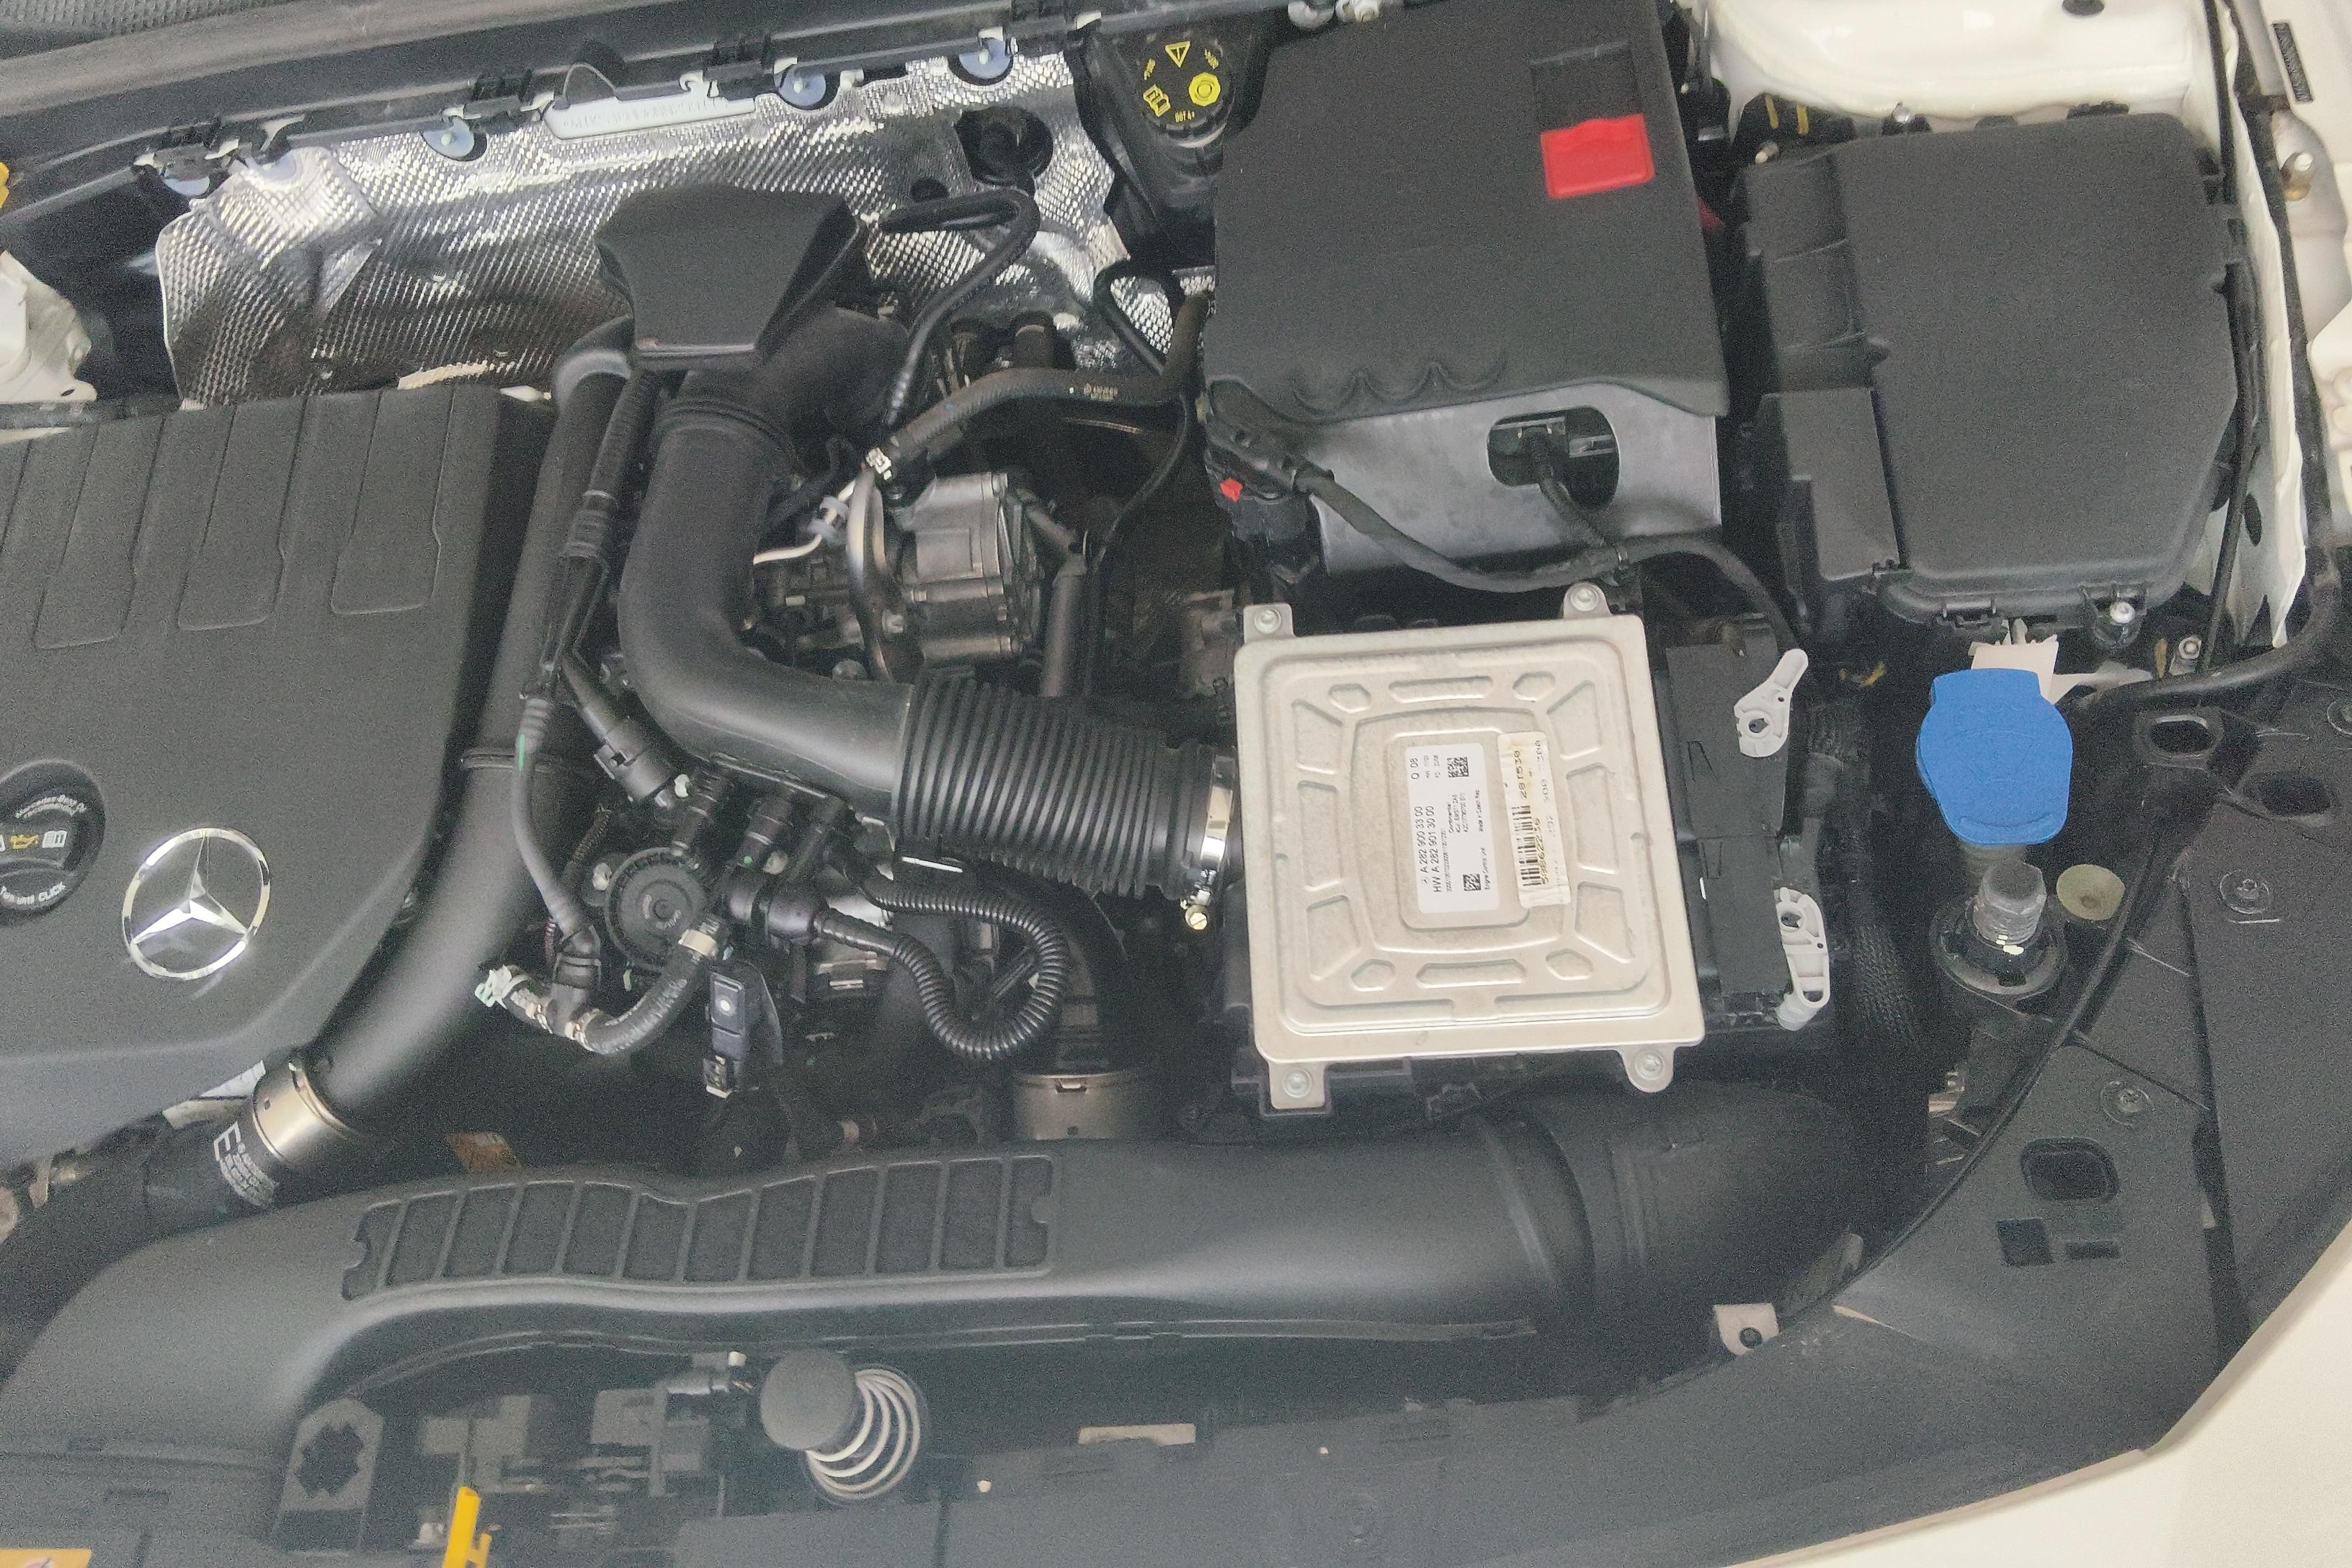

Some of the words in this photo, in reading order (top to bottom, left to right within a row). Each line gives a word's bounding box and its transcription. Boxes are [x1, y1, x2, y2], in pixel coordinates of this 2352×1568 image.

[1414, 806, 1423, 816] 00
[1425, 806, 1434, 816] 00
[1426, 818, 1435, 829] 30
[1416, 831, 1426, 846] 900
[1427, 832, 1437, 846] 901
[1418, 849, 1427, 865] 282
[1429, 848, 1439, 865] 282
[38, 881, 66, 902] CLICK
[1432, 876, 1441, 892] HW
